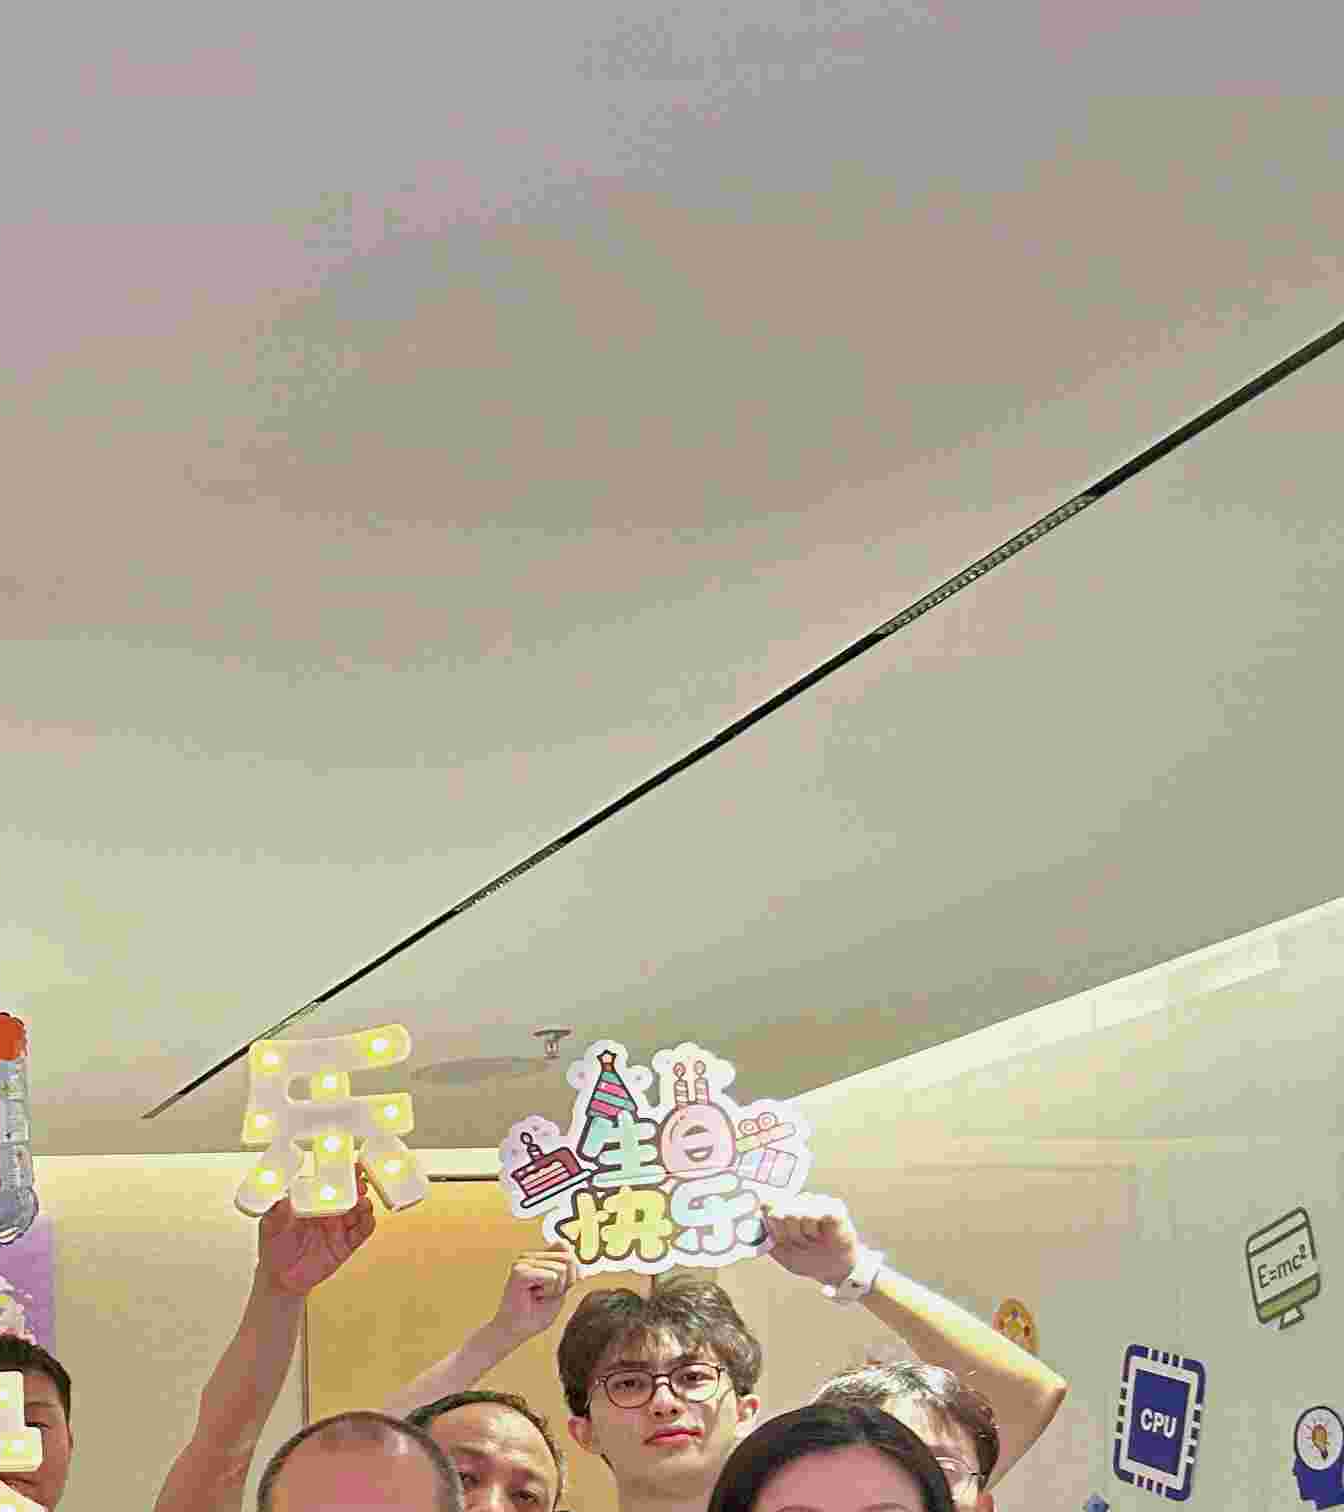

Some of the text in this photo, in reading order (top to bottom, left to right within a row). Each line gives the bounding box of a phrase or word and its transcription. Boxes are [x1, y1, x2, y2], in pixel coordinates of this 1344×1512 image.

[234, 1024, 429, 1217] 乐
[561, 1174, 771, 1265] 快乐
[1140, 1407, 1178, 1441] CPU
